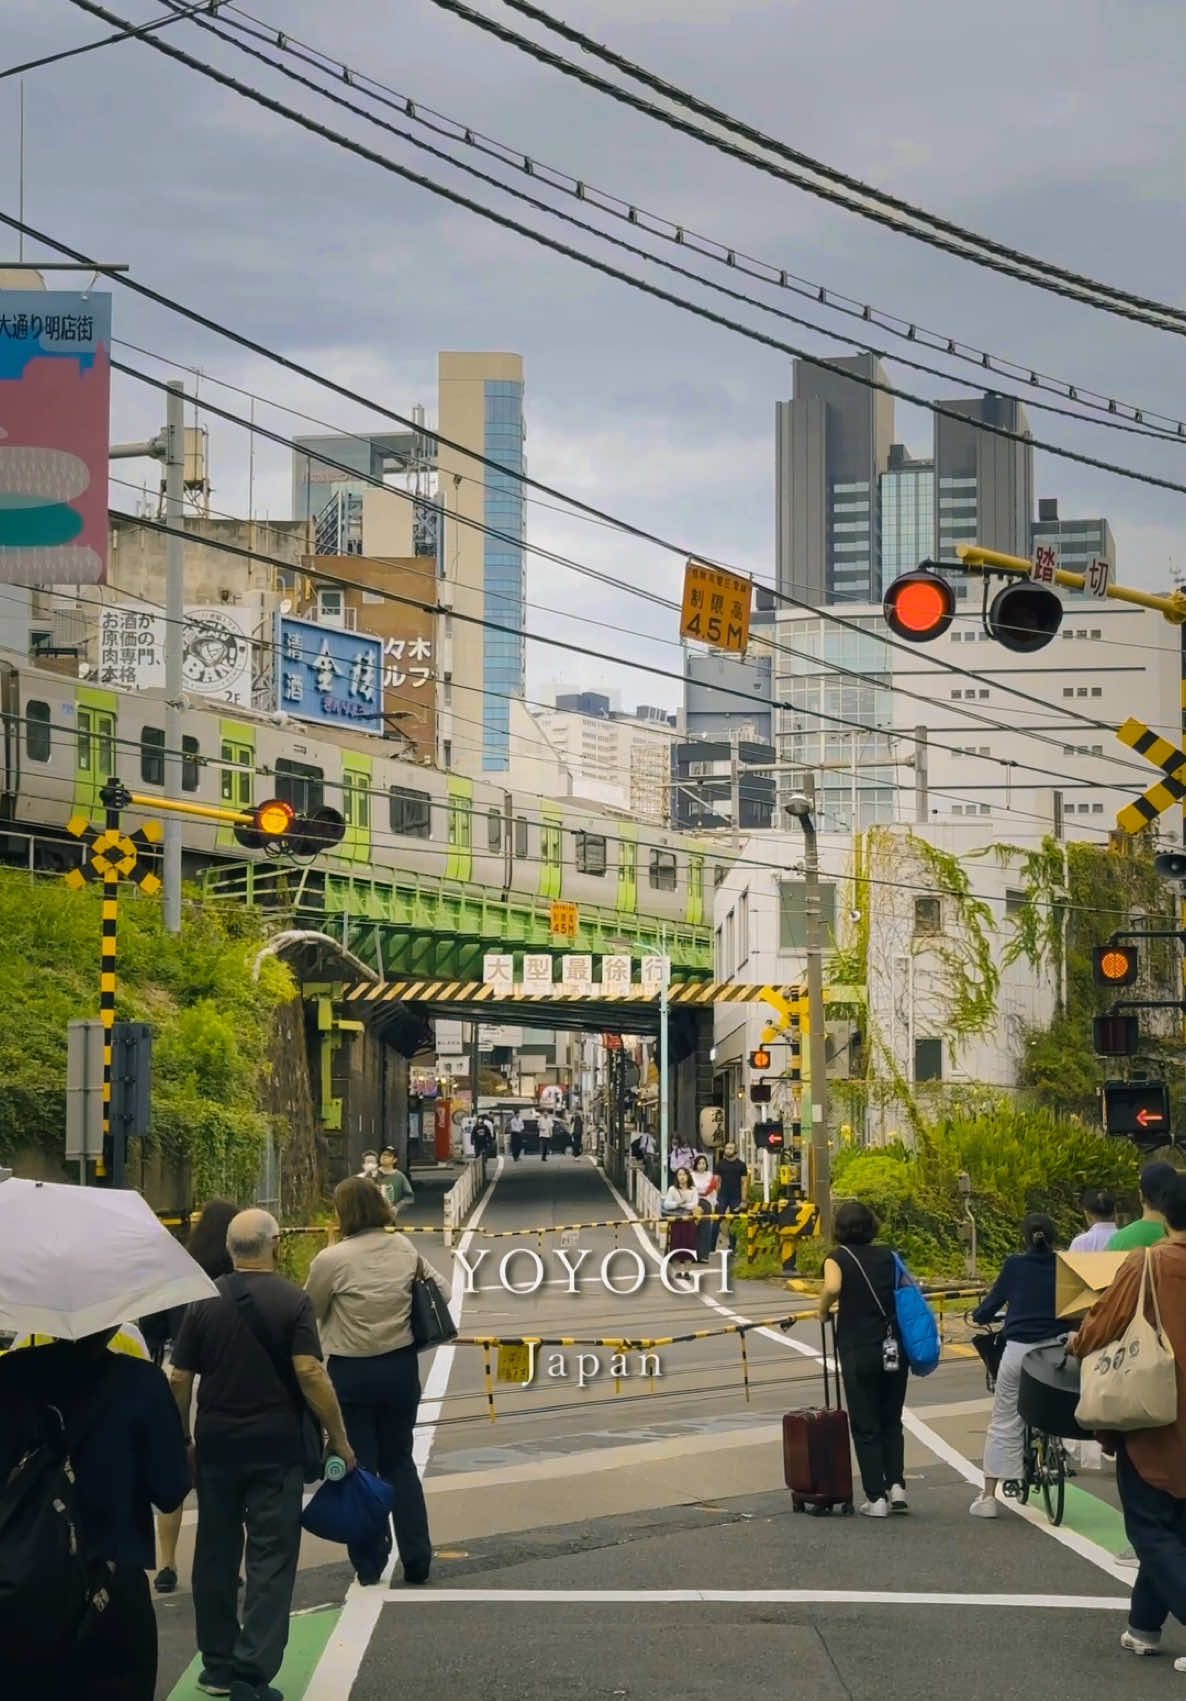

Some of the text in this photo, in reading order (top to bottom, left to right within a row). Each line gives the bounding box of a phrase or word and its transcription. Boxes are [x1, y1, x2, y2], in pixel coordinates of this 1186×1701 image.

[1034, 546, 1109, 597] 踏切
[102, 612, 155, 629] お酒が
[102, 631, 155, 647] 原価の
[102, 666, 137, 683] 本格
[487, 957, 665, 982] 大型最徐行
